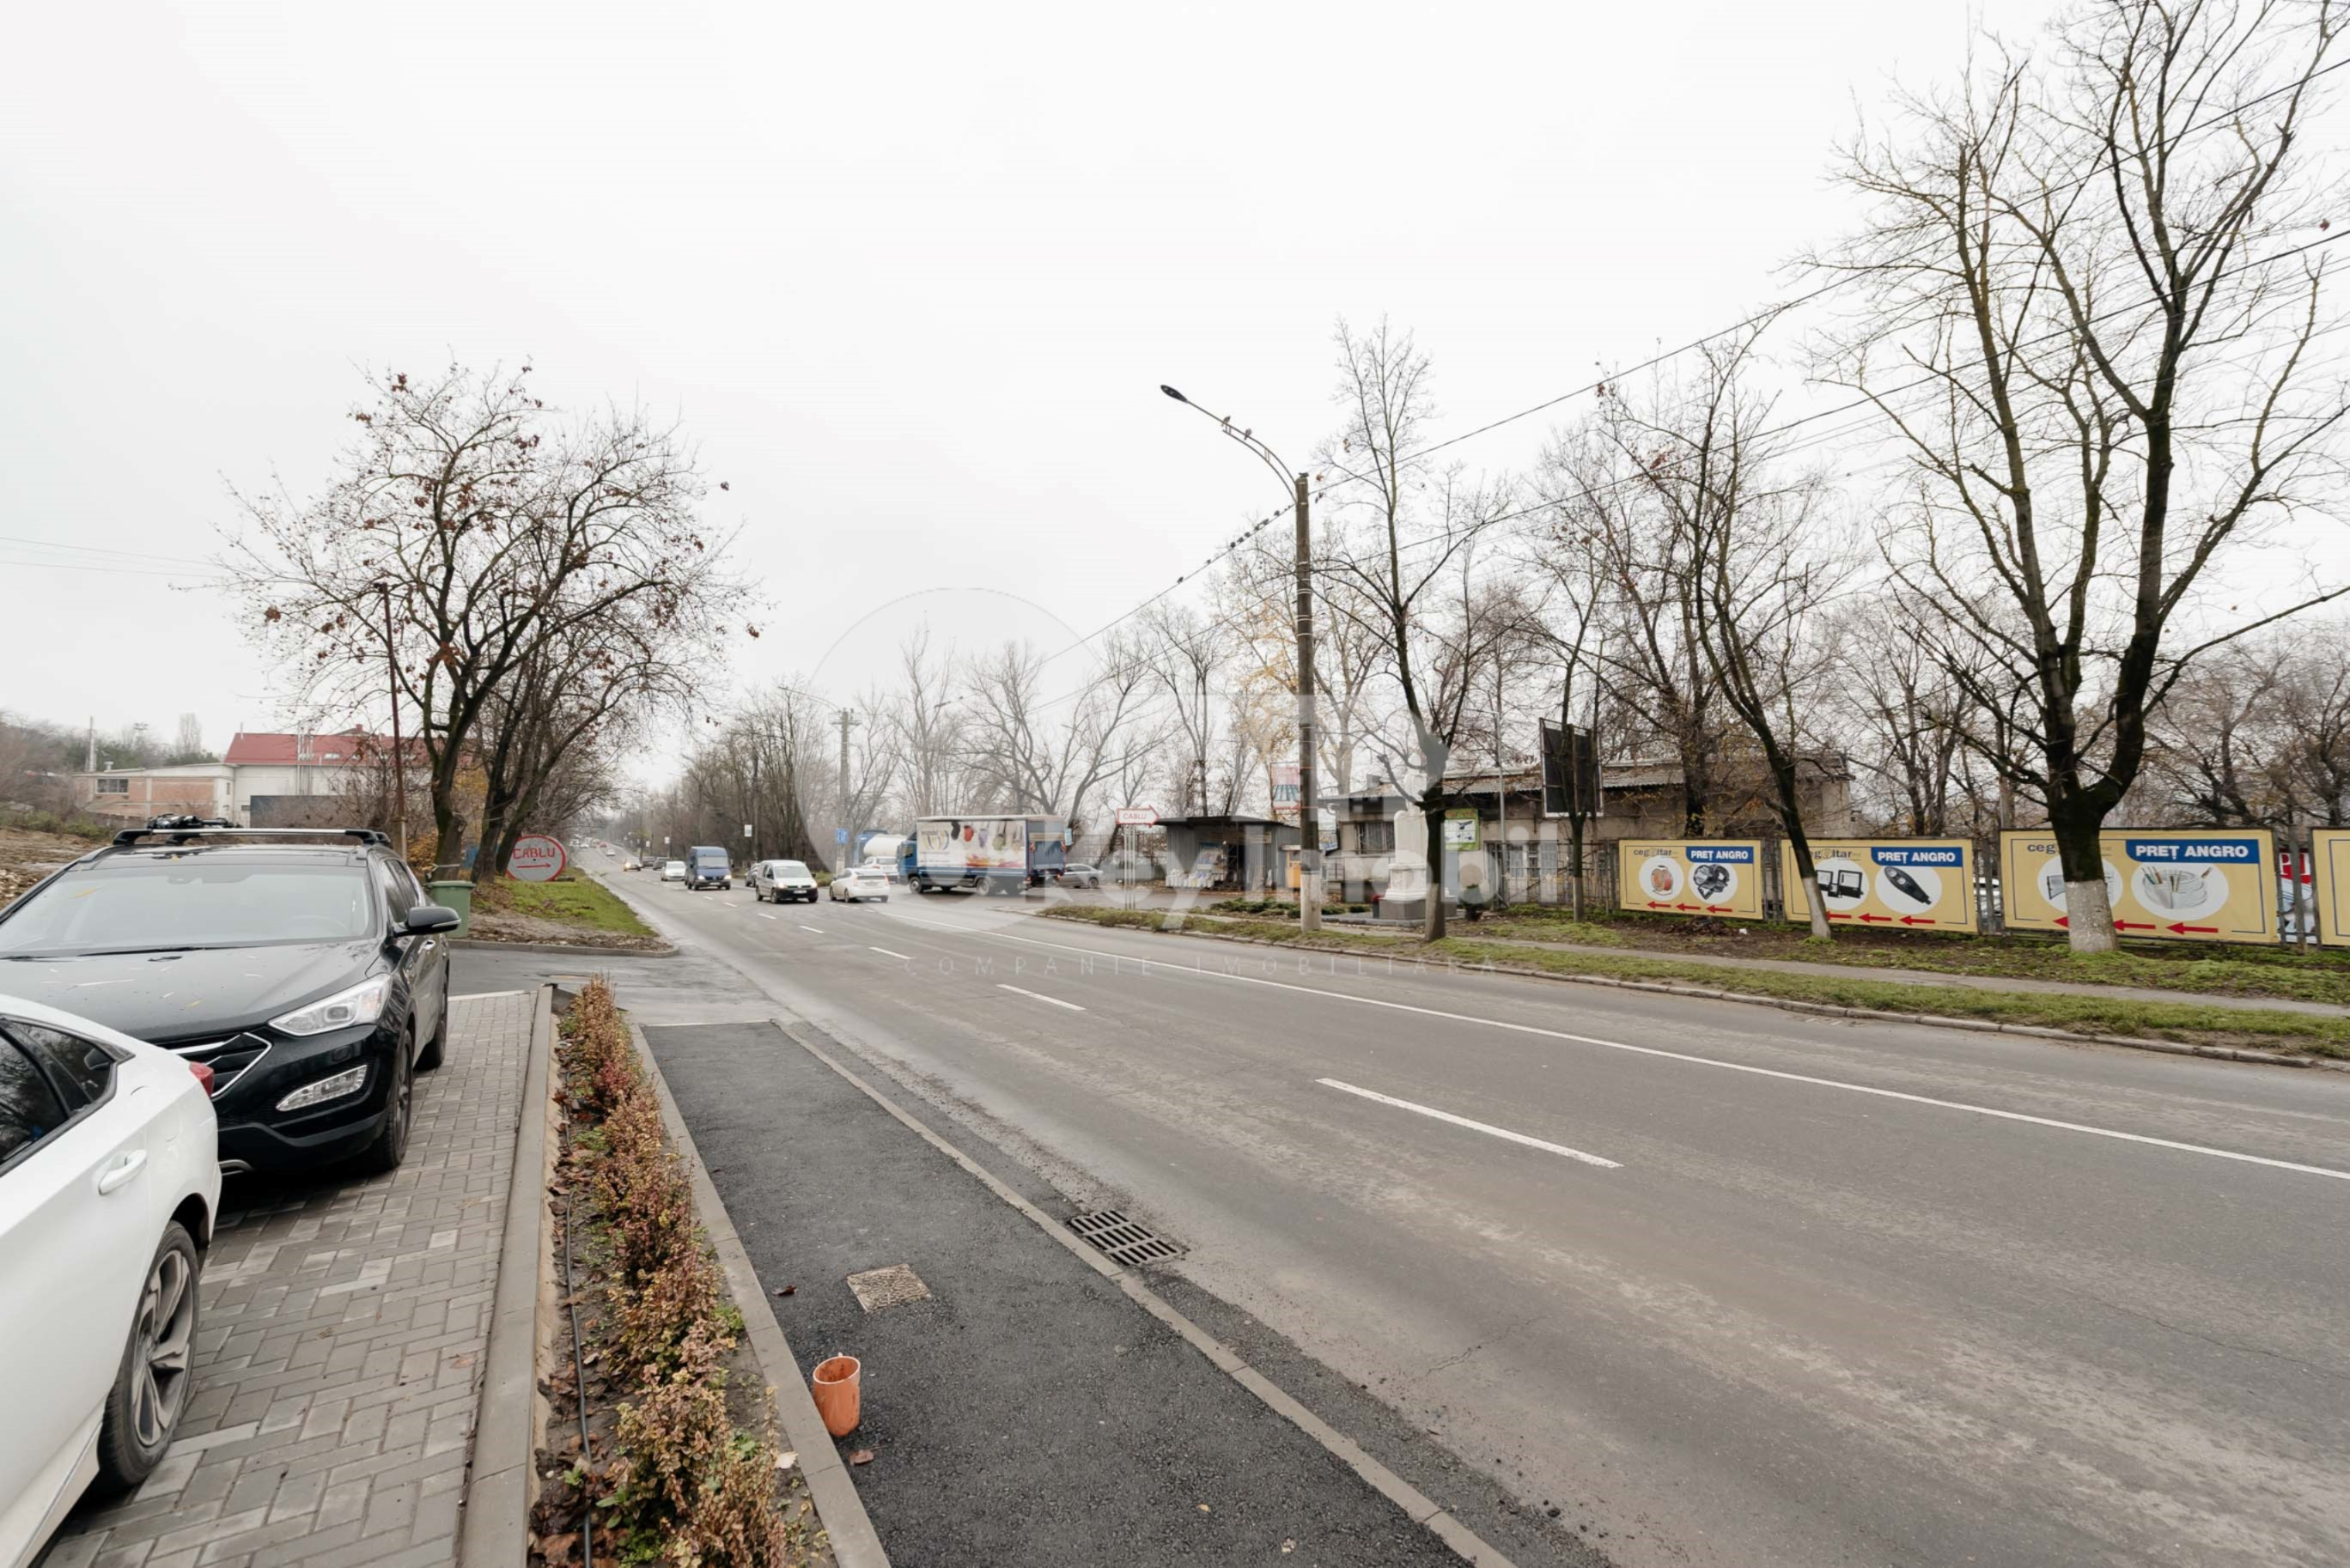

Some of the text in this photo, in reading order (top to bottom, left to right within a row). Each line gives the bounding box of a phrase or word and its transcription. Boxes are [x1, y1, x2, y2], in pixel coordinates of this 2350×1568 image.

[513, 848, 555, 860] CABLU
[1715, 851, 1749, 860] ANGRO
[1911, 852, 1956, 862] ANGRO
[2184, 845, 2249, 858] ANGRO
